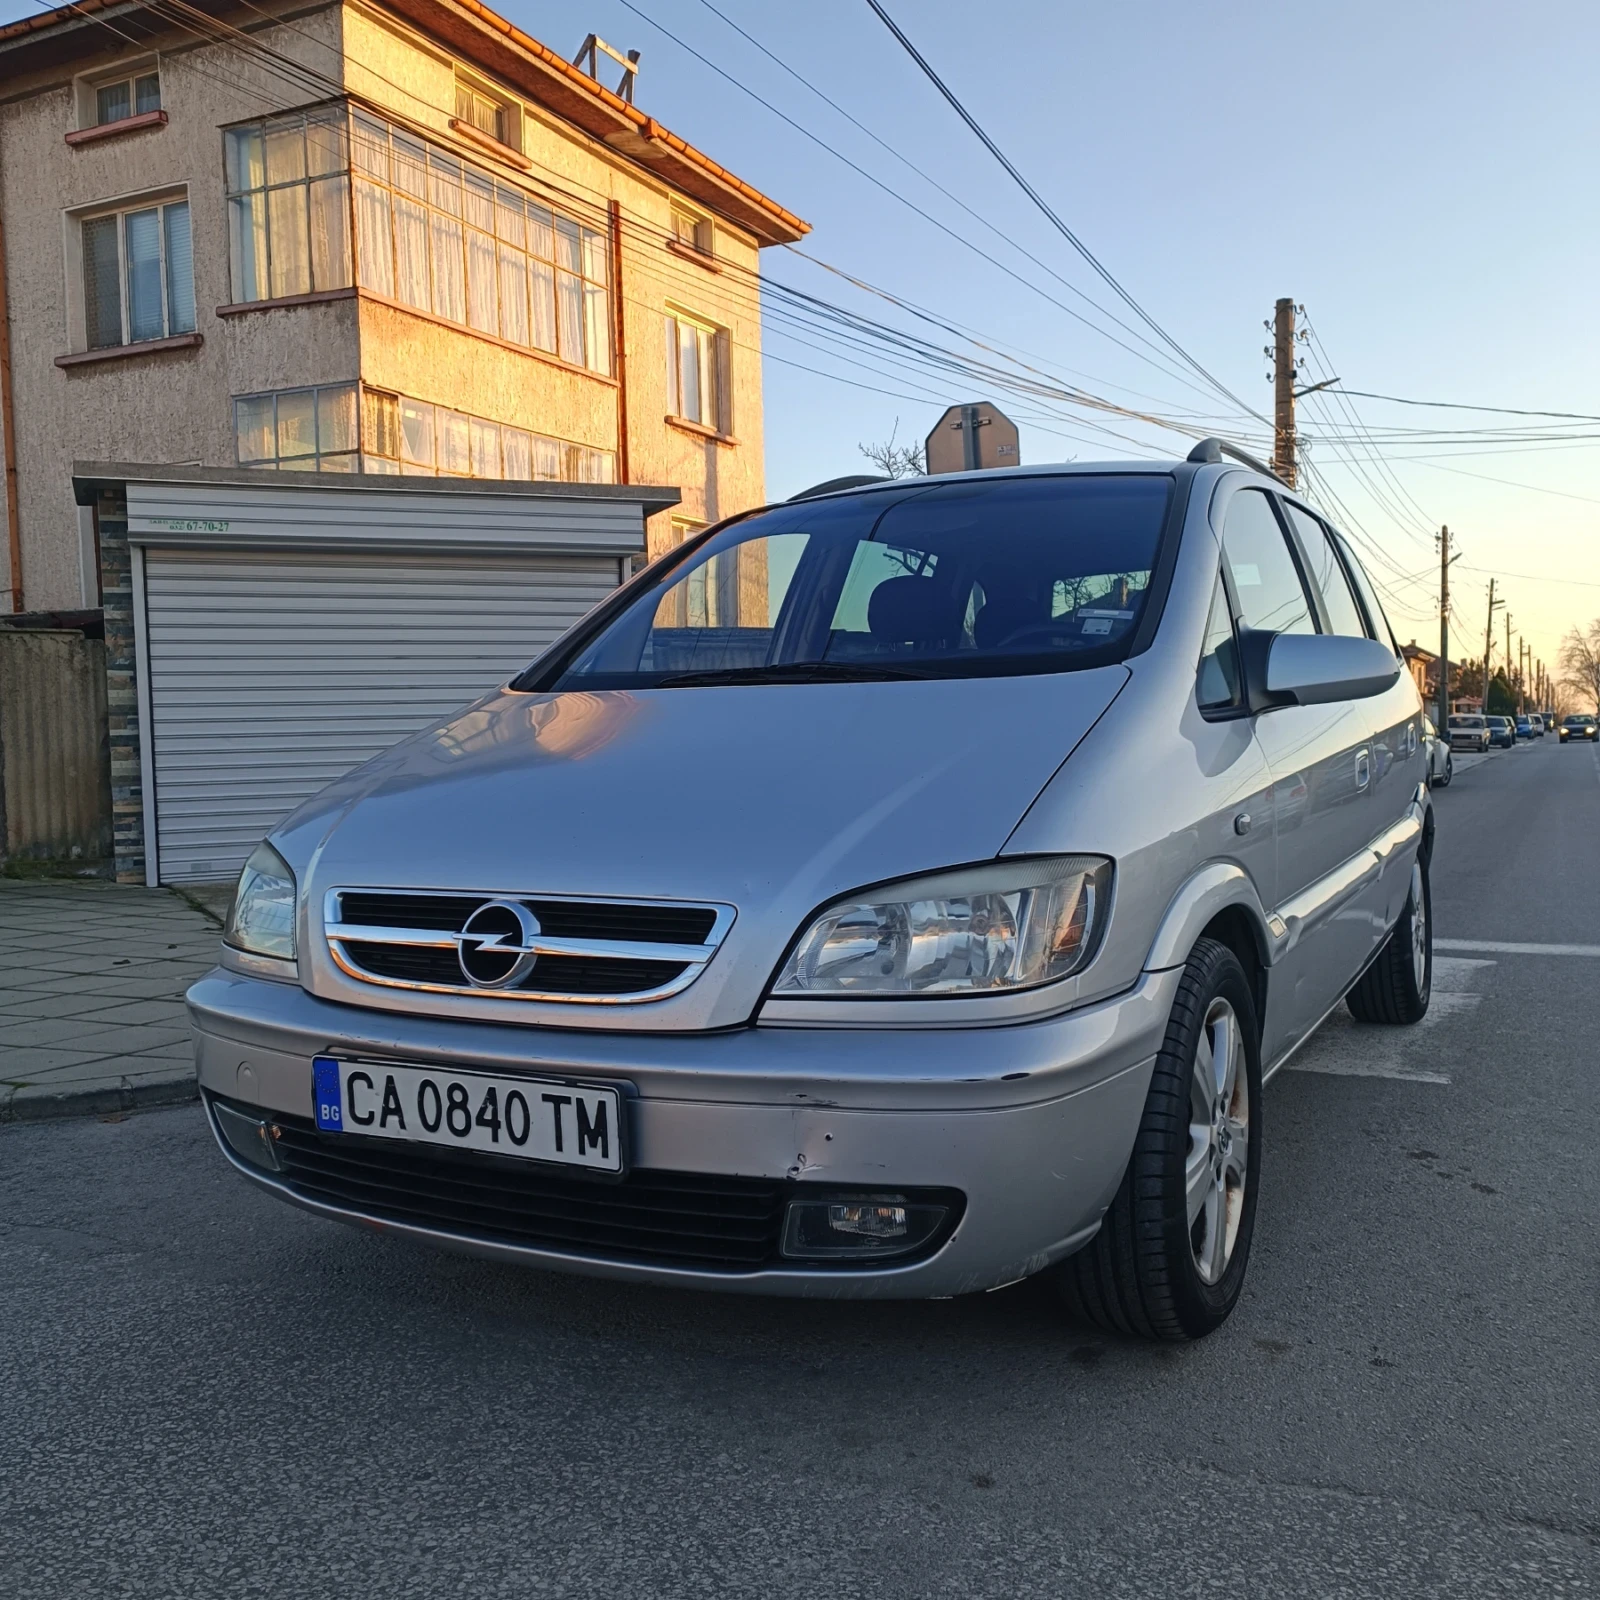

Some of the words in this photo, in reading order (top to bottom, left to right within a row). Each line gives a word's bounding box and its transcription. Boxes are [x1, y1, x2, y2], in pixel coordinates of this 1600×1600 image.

[186, 521, 230, 532] 67-70-27
[321, 1104, 340, 1122] BG
[347, 1071, 407, 1131] CA
[417, 1078, 531, 1147] 0840
[541, 1092, 609, 1159] TM
